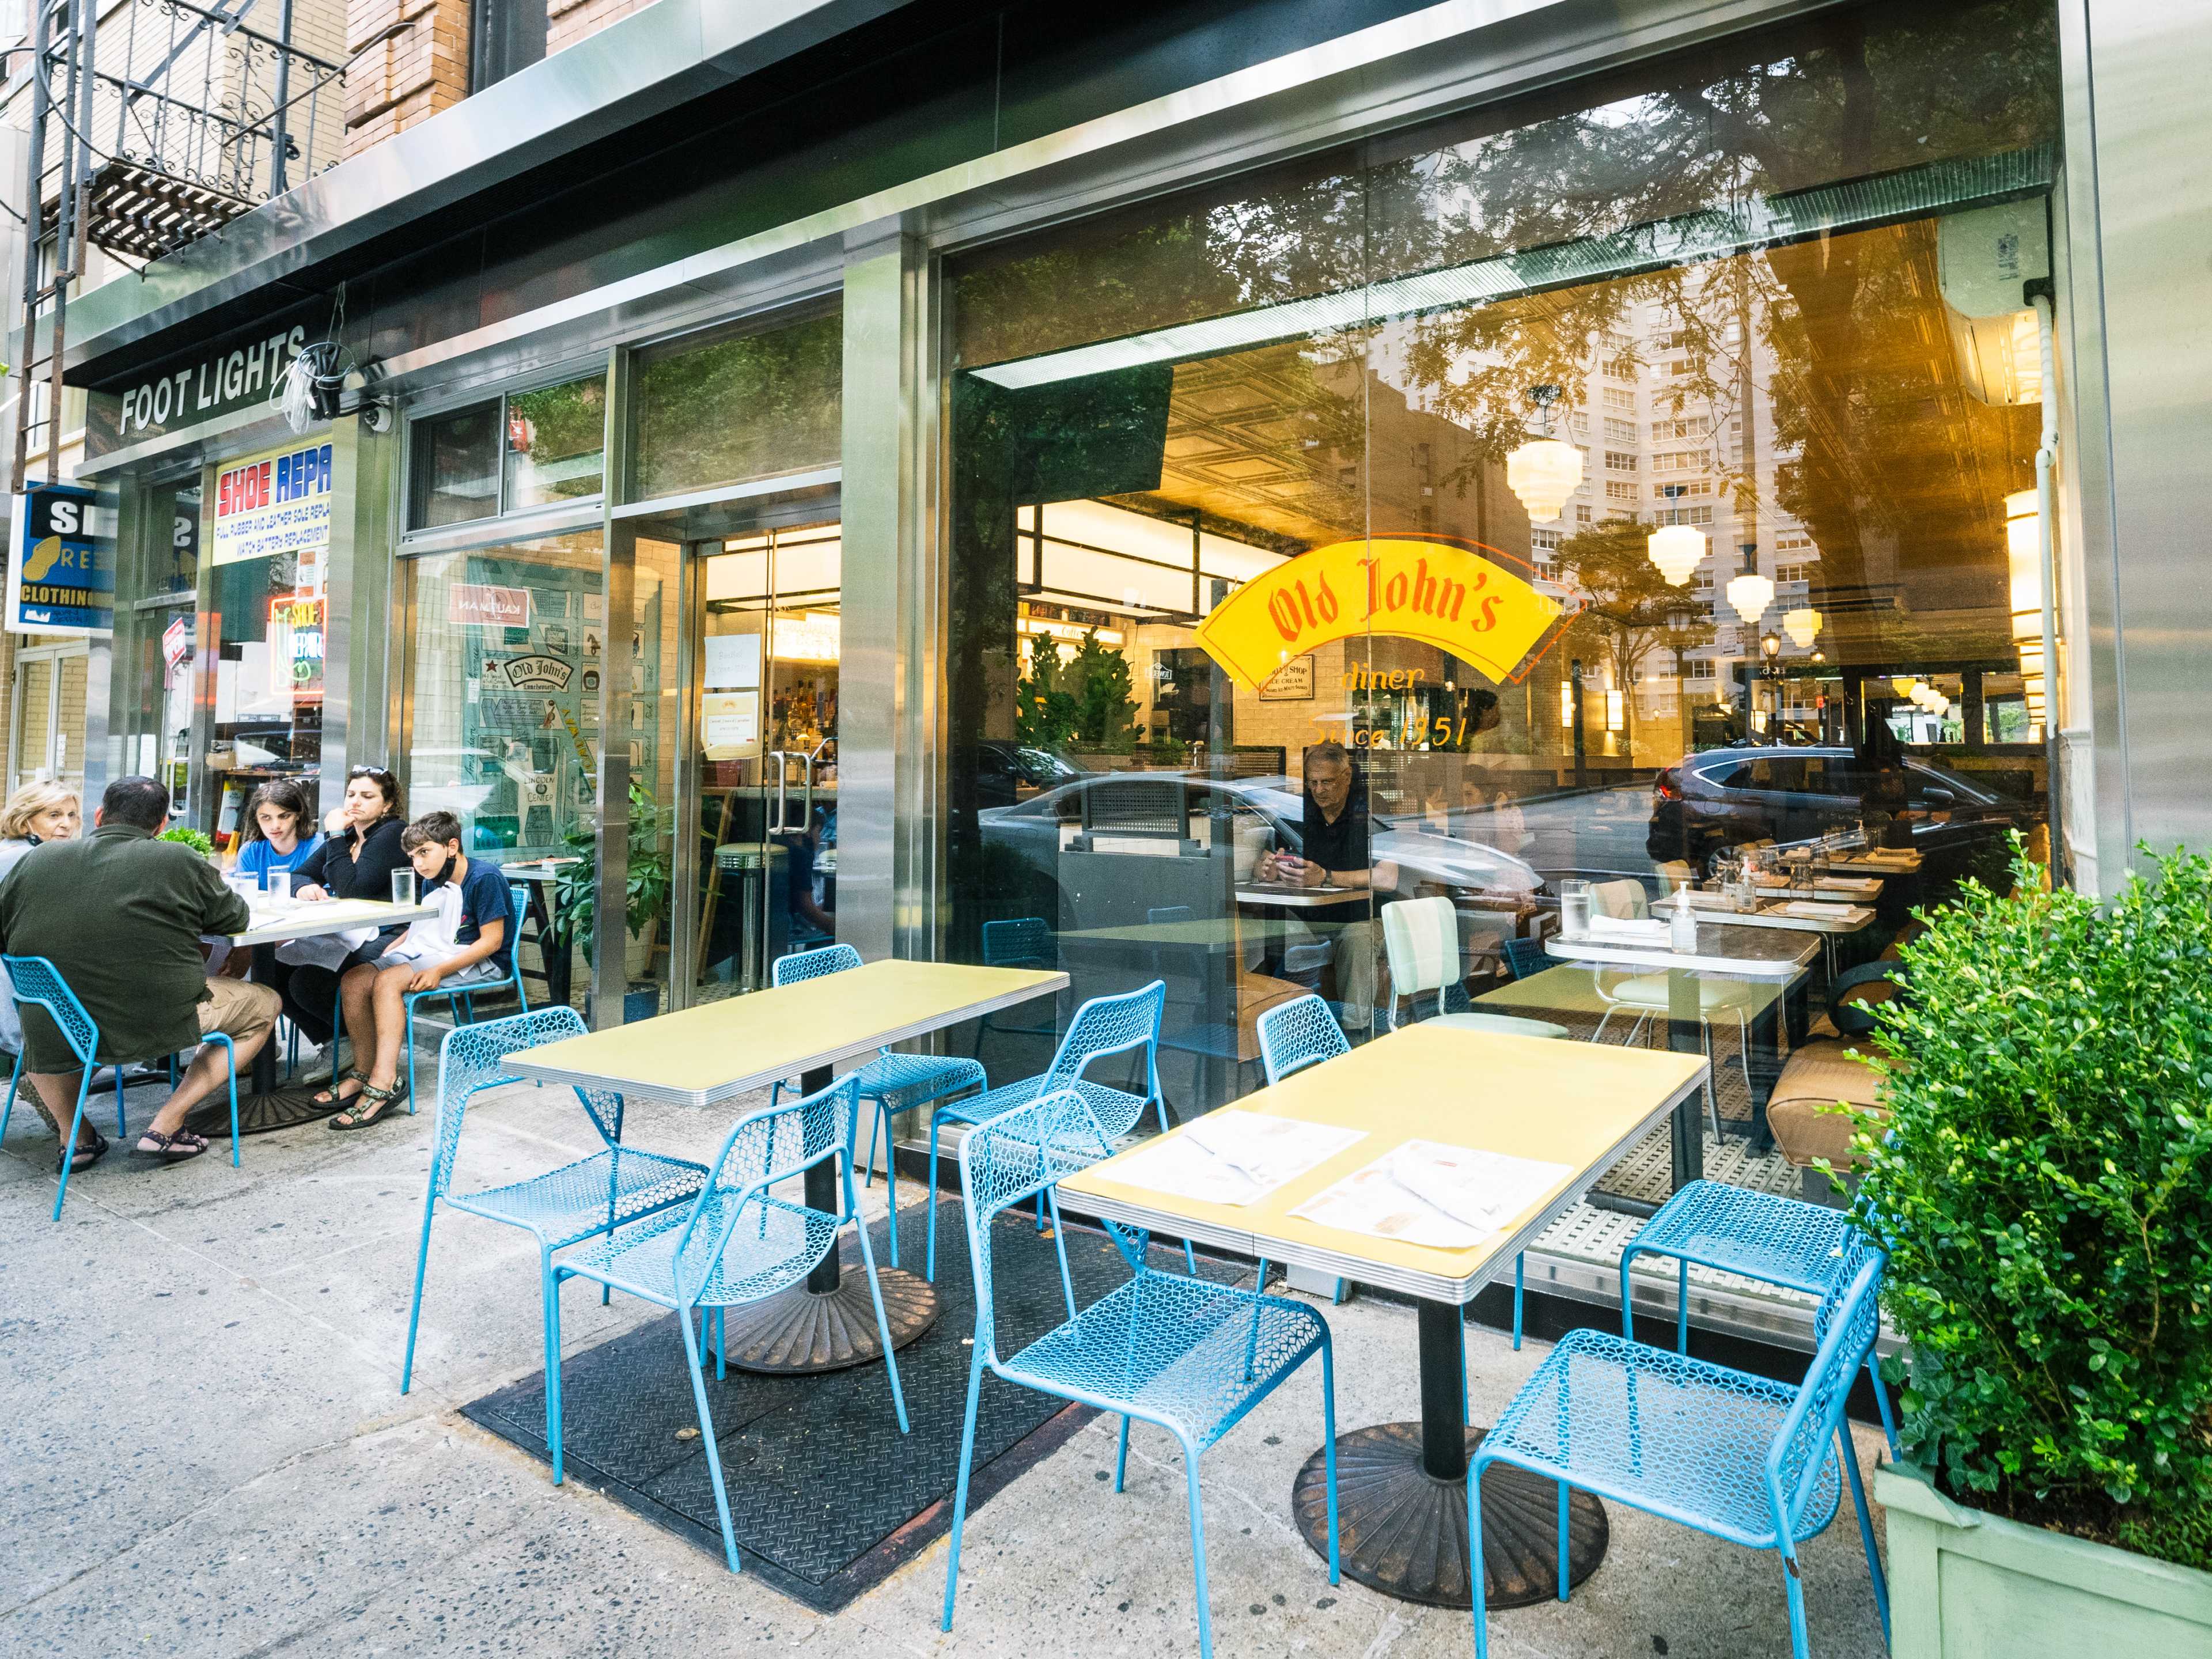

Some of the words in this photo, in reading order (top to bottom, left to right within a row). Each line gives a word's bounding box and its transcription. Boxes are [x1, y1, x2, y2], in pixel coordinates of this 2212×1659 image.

[120, 369, 192, 435] FOOT
[197, 325, 304, 411] LIGHTS
[218, 461, 271, 517] SHOE
[230, 520, 253, 536] RUBBER
[254, 516, 265, 531] AND
[267, 510, 292, 529] LEATHER
[294, 506, 309, 524] SOLE
[237, 539, 256, 556] WATCH
[257, 533, 282, 554] BATTERY
[285, 524, 329, 547] REPLACEMENT
[1268, 571, 1338, 642] Old
[1357, 558, 1503, 632] John's
[292, 603, 319, 628] SHOE
[512, 661, 533, 679] Old
[536, 659, 568, 680] John's
[1289, 666, 1308, 675] SHOP
[1342, 662, 1425, 691] diner
[1400, 717, 1467, 746] 1951
[527, 792, 553, 803] CENTER
